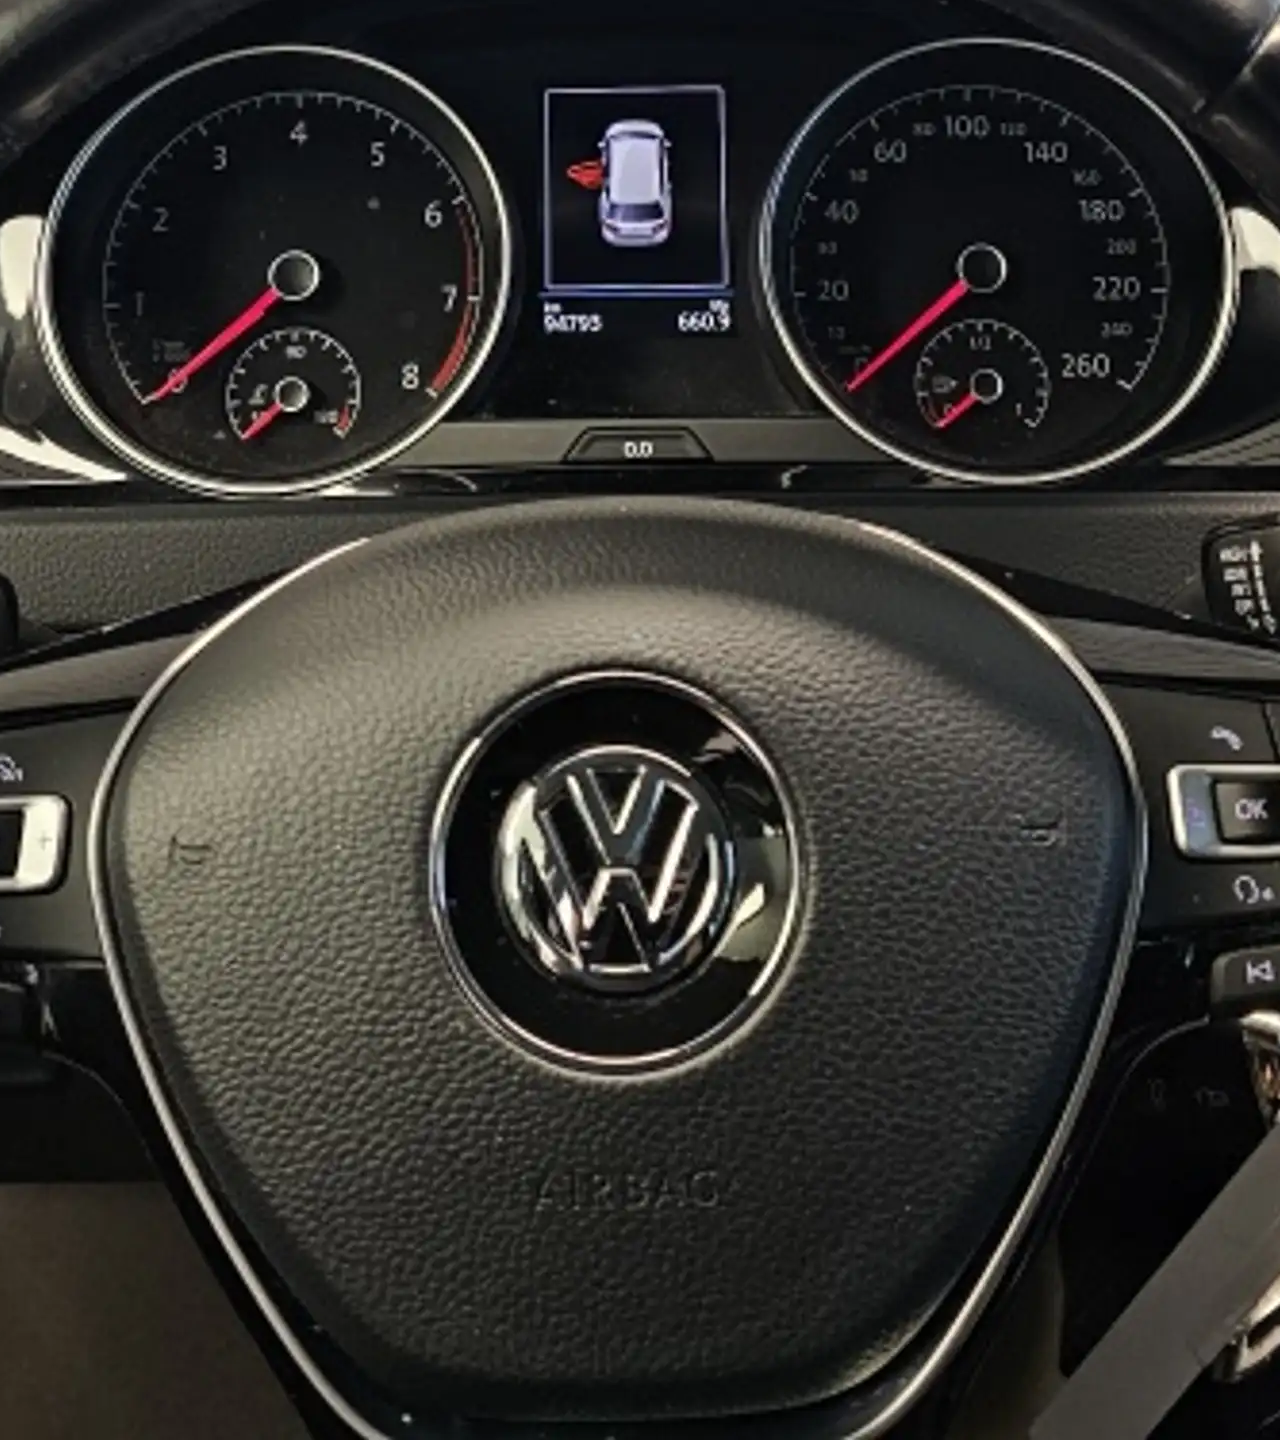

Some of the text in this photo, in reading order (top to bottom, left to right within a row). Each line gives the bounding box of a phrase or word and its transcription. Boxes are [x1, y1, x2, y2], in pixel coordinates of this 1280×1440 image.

[290, 121, 308, 145] 4
[944, 115, 989, 139] 100
[213, 146, 228, 171] 3
[370, 142, 386, 167] 5
[874, 140, 907, 162] 60
[1025, 140, 1068, 163] 140
[152, 207, 169, 232] 2
[424, 201, 443, 227] 6
[824, 199, 860, 224] 40
[1079, 199, 1125, 223] 180
[441, 286, 458, 312] 7
[817, 278, 850, 302] 20
[1092, 276, 1141, 301] 220
[134, 292, 145, 317] 1
[401, 363, 420, 390] 8
[1061, 353, 1111, 379] 260
[1233, 797, 1269, 821] OK
